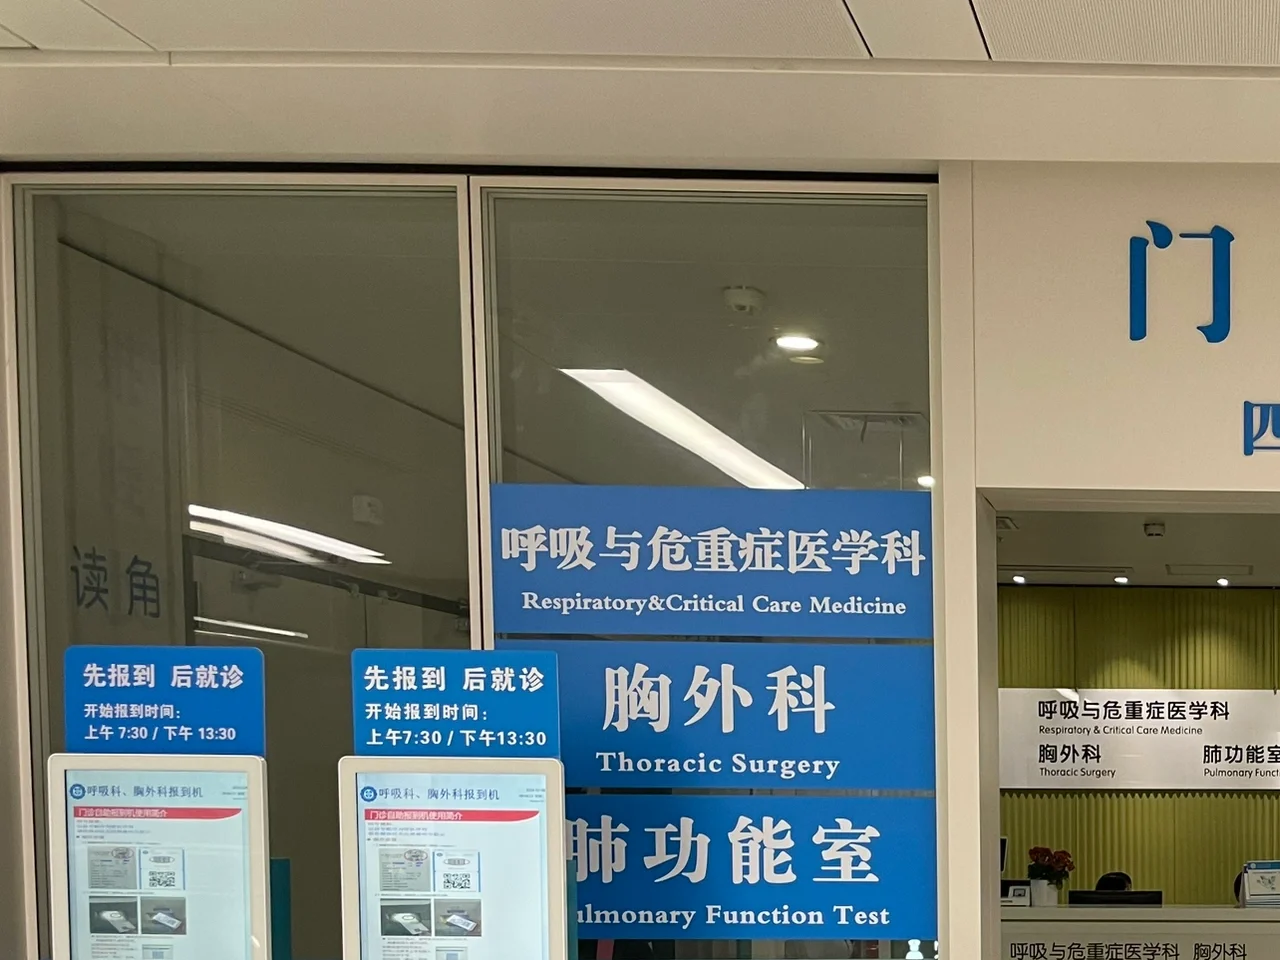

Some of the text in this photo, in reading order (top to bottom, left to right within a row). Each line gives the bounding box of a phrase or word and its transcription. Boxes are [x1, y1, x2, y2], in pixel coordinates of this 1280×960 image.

[501, 525, 926, 576] 呼吸与危重症医学科
[522, 592, 907, 616] Respiratory&Critical Care Medicine
[83, 663, 244, 689] 先报到 后就诊
[364, 665, 545, 692] 先报到 后就诊
[603, 662, 835, 734] 胸外科
[84, 703, 180, 719] 开始报到时间：
[365, 703, 488, 721] 开始报到时间：
[1038, 700, 1230, 721] 呼吸与危重症医学科
[84, 725, 114, 741] 上午
[119, 727, 148, 739] 7:30
[164, 726, 193, 741] 下午
[198, 728, 236, 740] 13:30
[1039, 724, 1203, 736] Respiratory & Critical Care Medicine
[1038, 744, 1102, 764] 胸外科
[596, 752, 840, 780] Thoracic Surgery
[1040, 767, 1116, 779] Thoracic Surgery
[1204, 767, 1253, 779] Pulmonary
[86, 785, 203, 798] 呼吸科、胸外科报到机
[378, 787, 499, 800] 呼吸科、胸外科报到机
[566, 815, 881, 884] 肺功能室
[705, 905, 824, 925] Function
[833, 905, 890, 925] Test
[1010, 942, 1180, 960] 呼吸与危重症医学科
[1193, 943, 1247, 960] 胸外科
